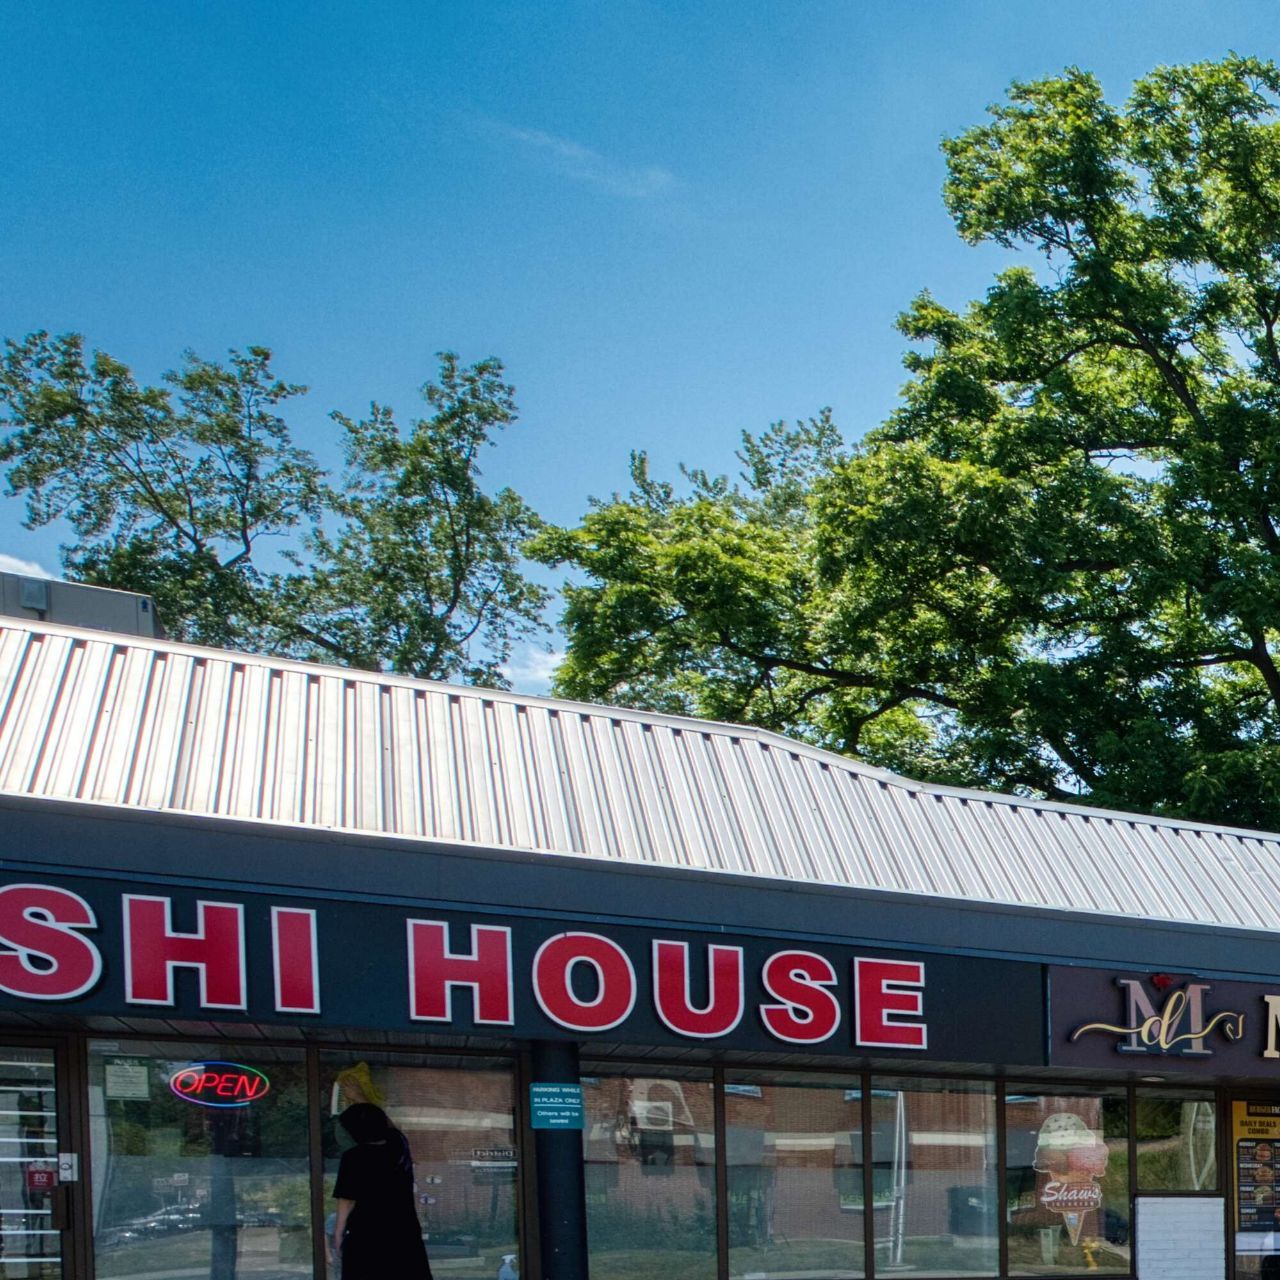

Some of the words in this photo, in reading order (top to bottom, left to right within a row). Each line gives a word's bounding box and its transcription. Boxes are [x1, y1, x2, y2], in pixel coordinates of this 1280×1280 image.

[0, 883, 321, 1014] SHI
[405, 917, 928, 1050] HOUSE
[174, 1071, 261, 1098] OPEN
